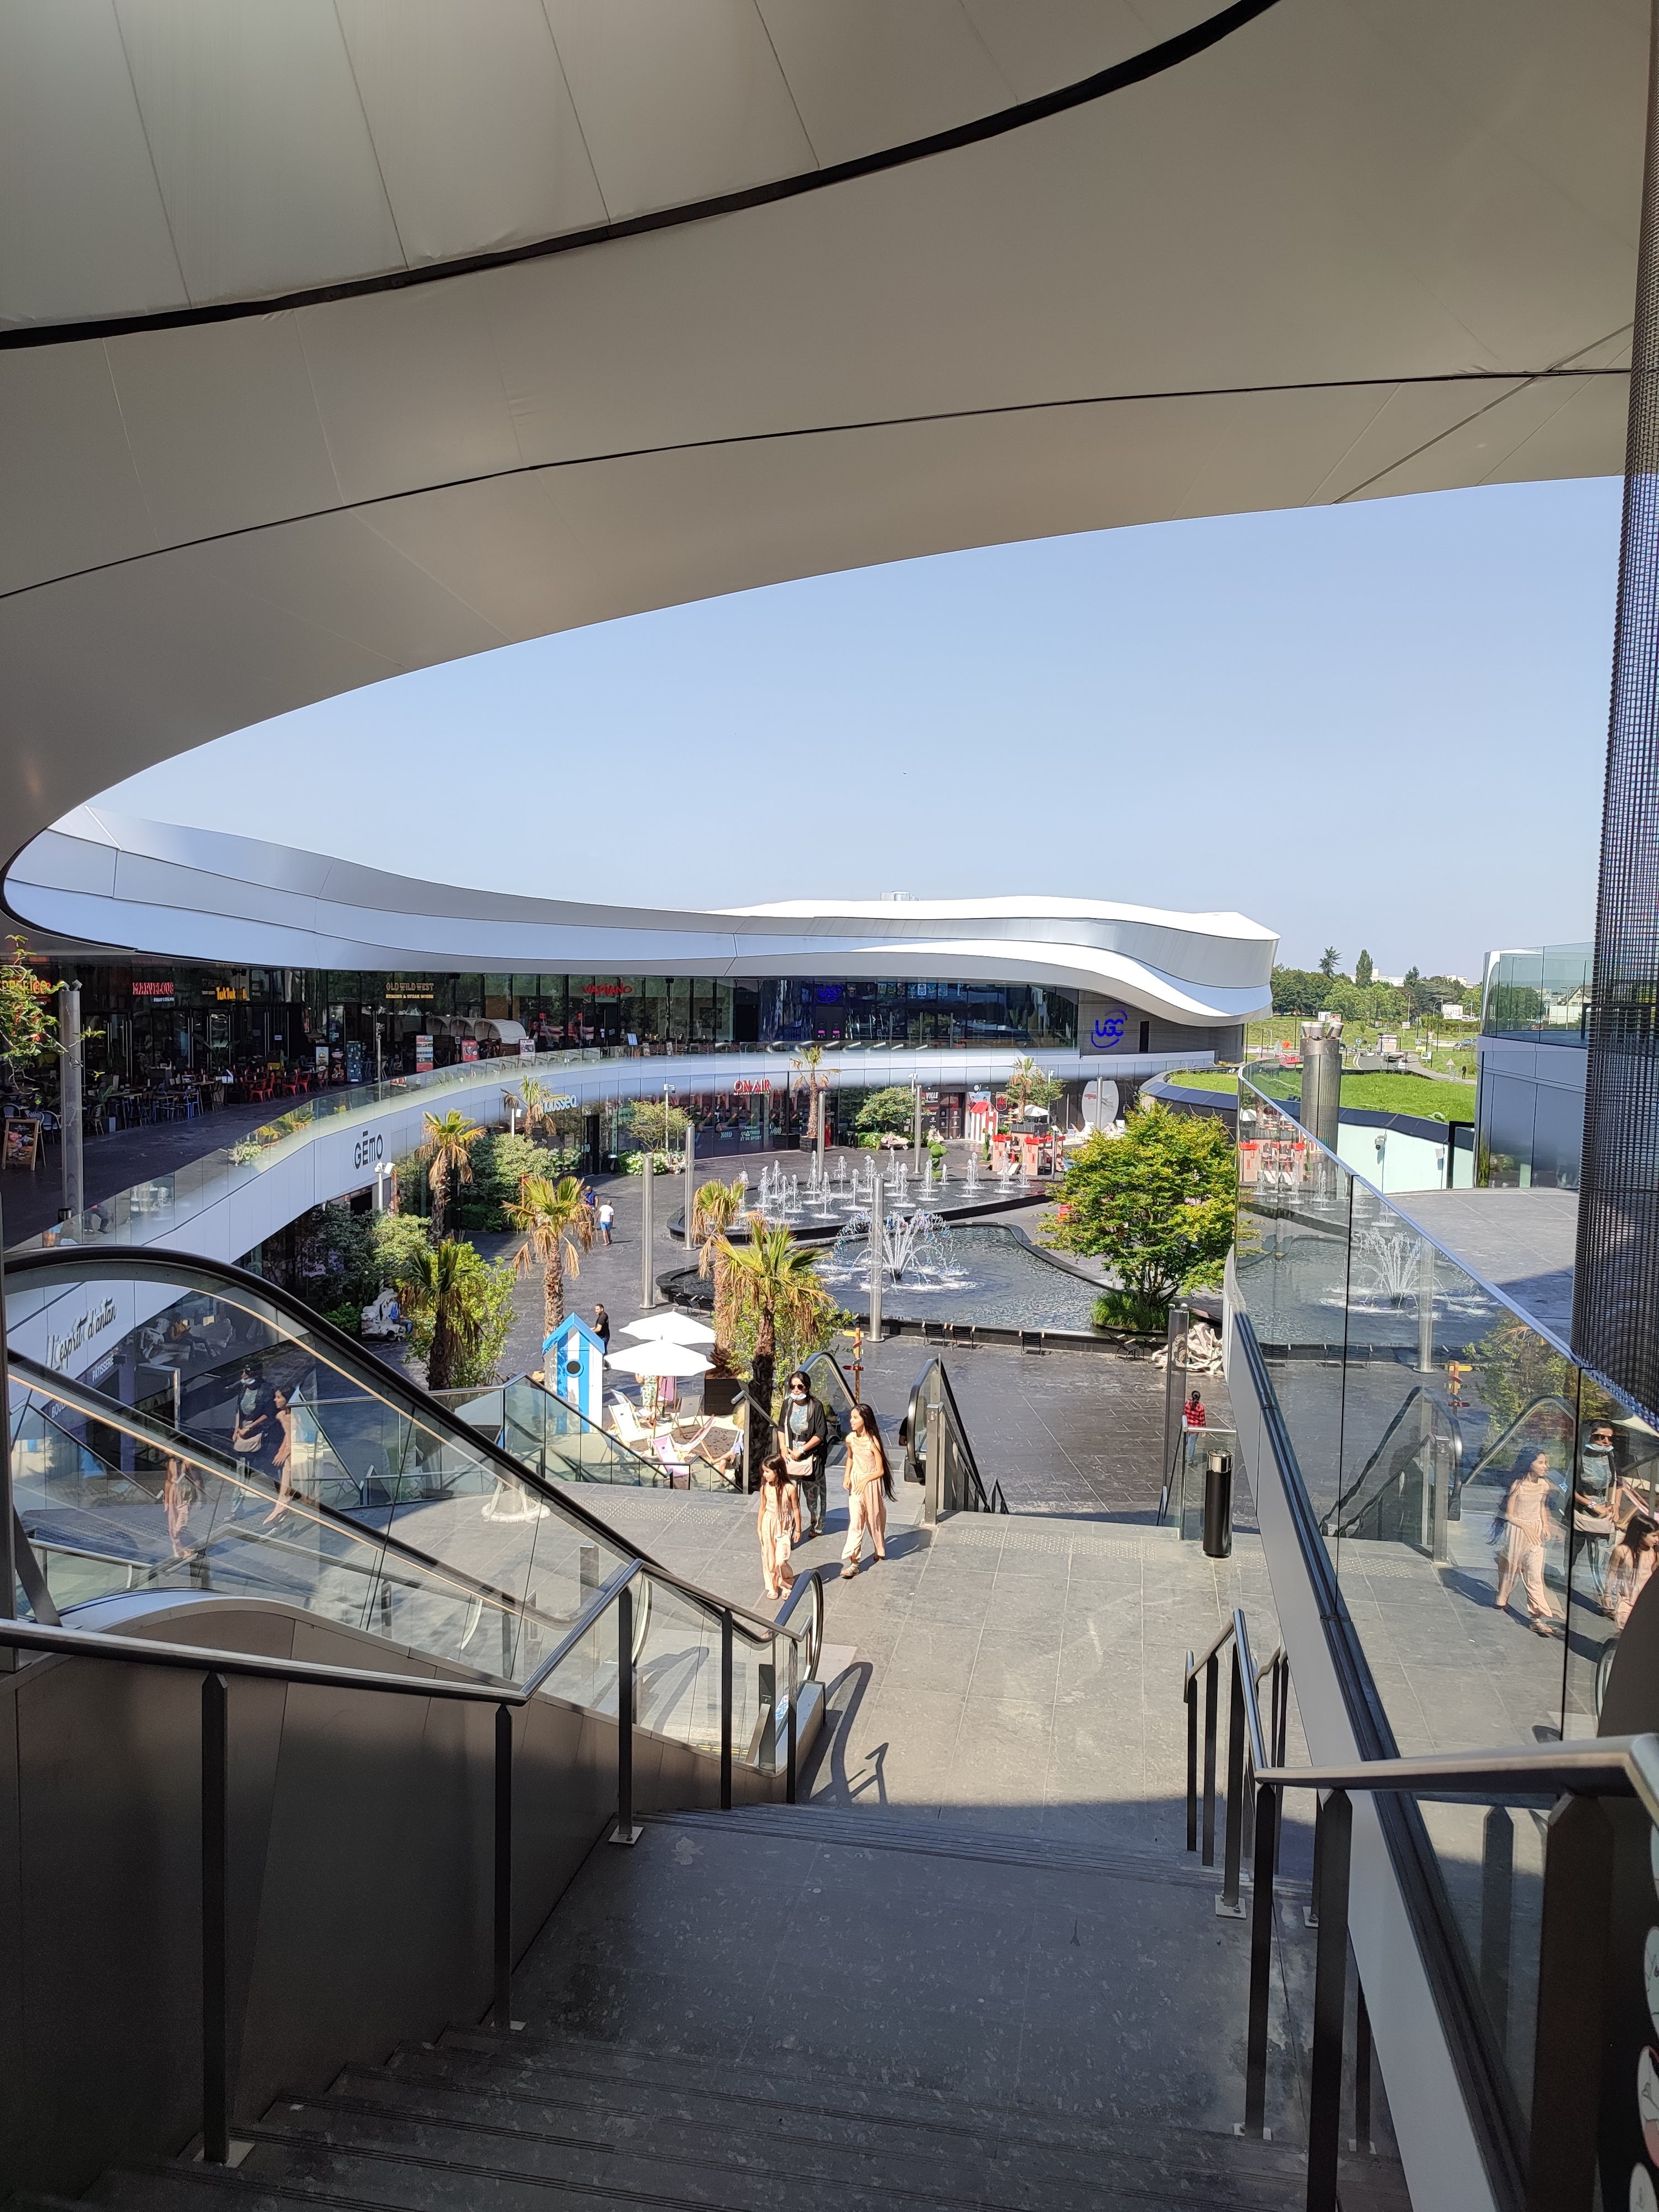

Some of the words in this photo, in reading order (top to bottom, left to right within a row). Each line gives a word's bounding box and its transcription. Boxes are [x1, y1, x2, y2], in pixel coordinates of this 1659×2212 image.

[133, 982, 174, 995] MARVELOUS
[386, 982, 399, 991] OLD
[399, 983, 416, 991] WILD
[416, 983, 434, 991] WEST
[1095, 1019, 1124, 1037] UGC
[734, 1079, 751, 1092] ON
[752, 1079, 770, 1092] AIR
[87, 1297, 117, 1340] d'antan
